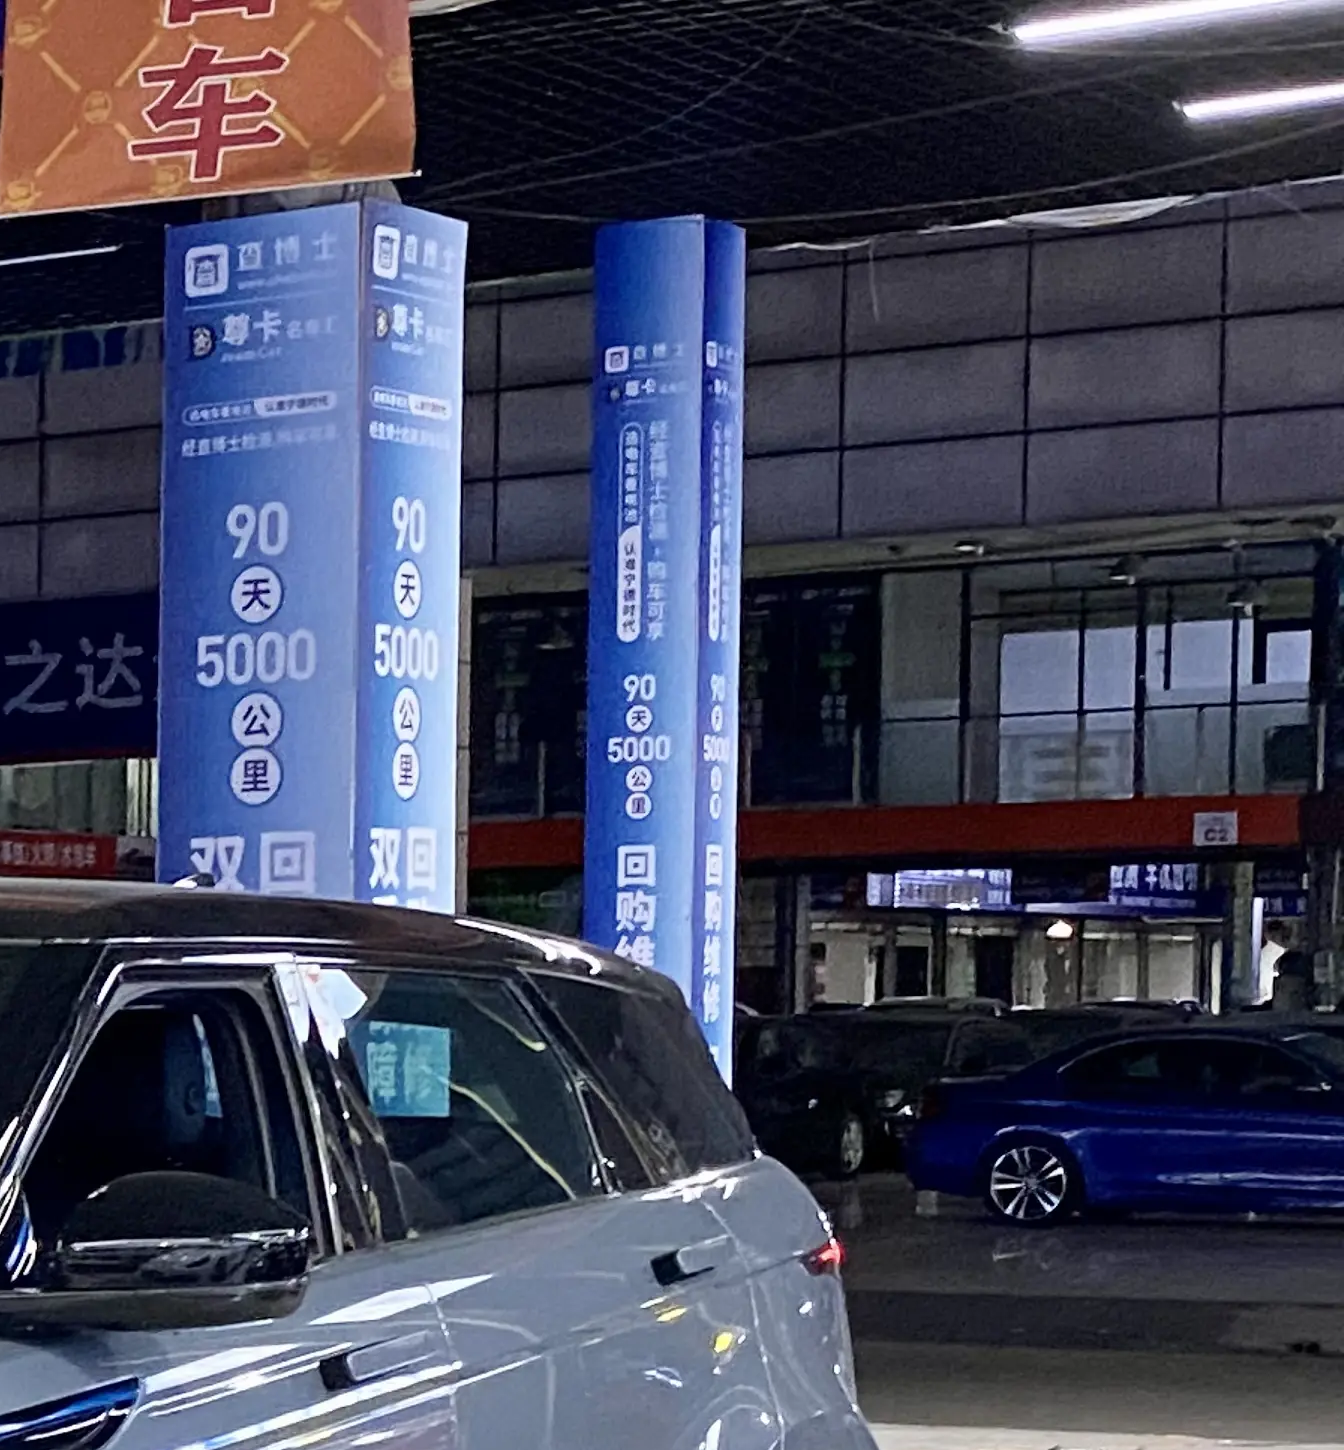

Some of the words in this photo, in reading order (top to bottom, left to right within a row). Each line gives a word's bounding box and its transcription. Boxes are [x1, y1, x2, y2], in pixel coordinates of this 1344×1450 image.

[226, 501, 289, 559] 90
[392, 496, 426, 553] 90
[196, 628, 317, 687] 5000
[374, 623, 439, 681] 5000
[623, 674, 657, 702] 90
[607, 736, 671, 763] 5000
[1204, 828, 1229, 842] C2
